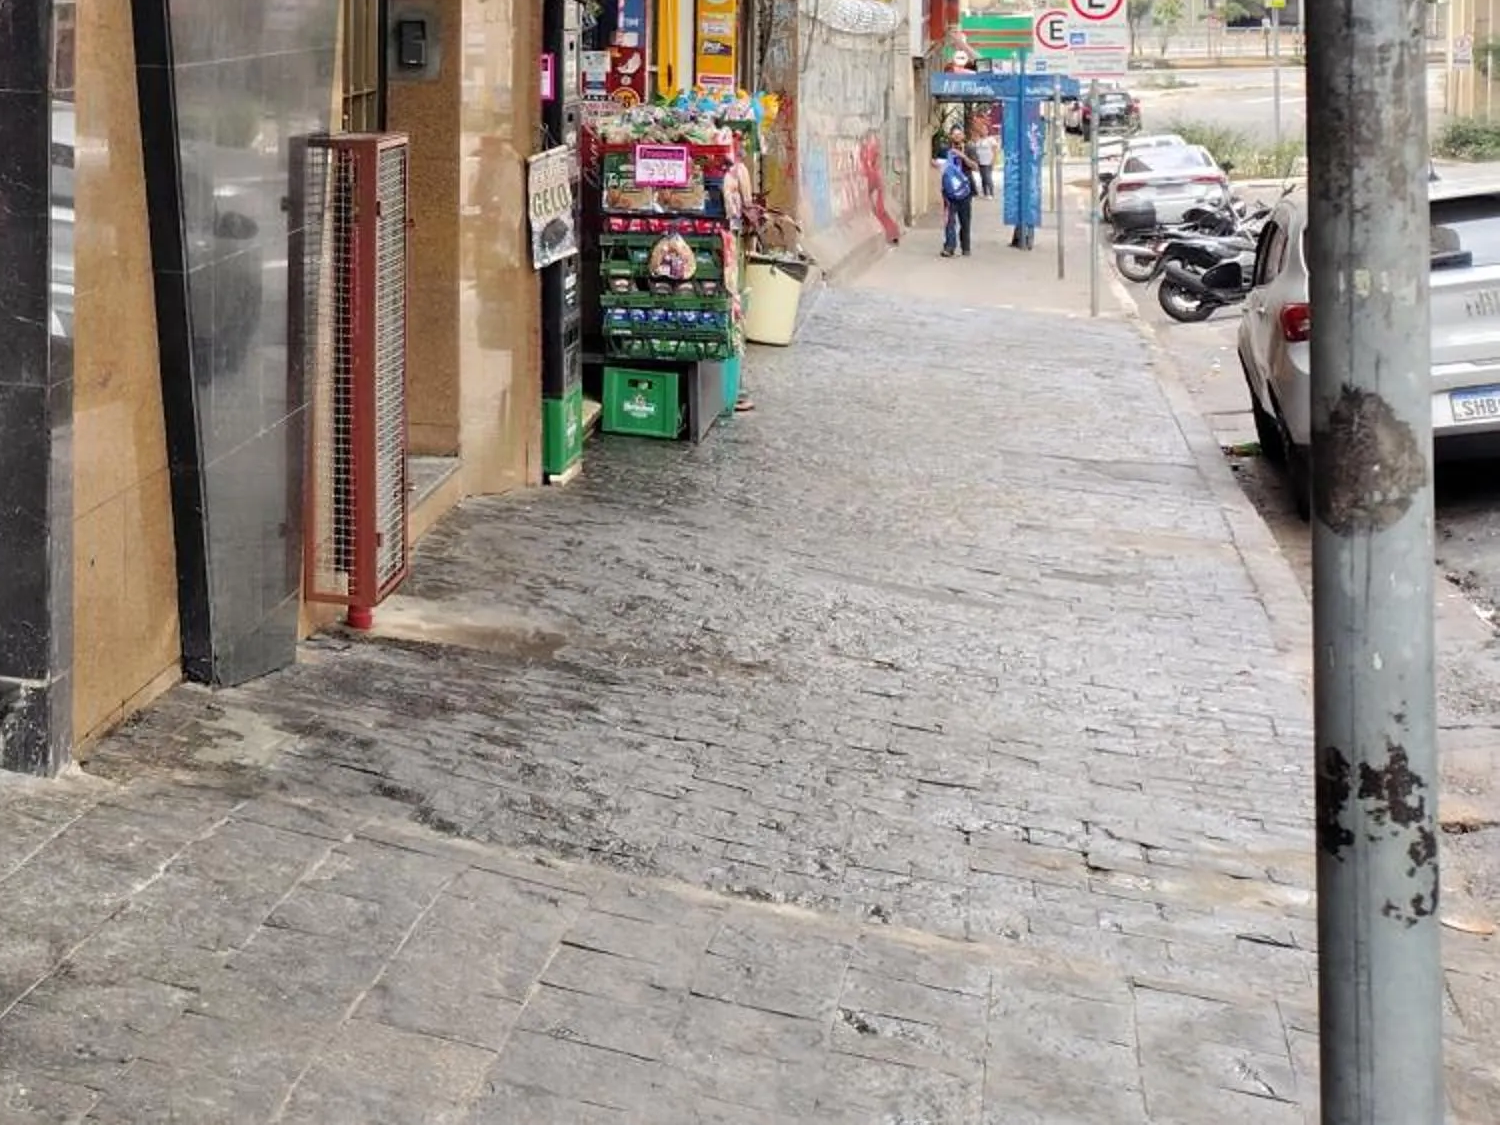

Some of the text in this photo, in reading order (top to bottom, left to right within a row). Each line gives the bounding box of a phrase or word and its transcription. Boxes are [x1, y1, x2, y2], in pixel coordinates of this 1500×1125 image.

[1049, 20, 1065, 41] E
[533, 181, 569, 217] GELO
[1461, 398, 1500, 416] SHB
